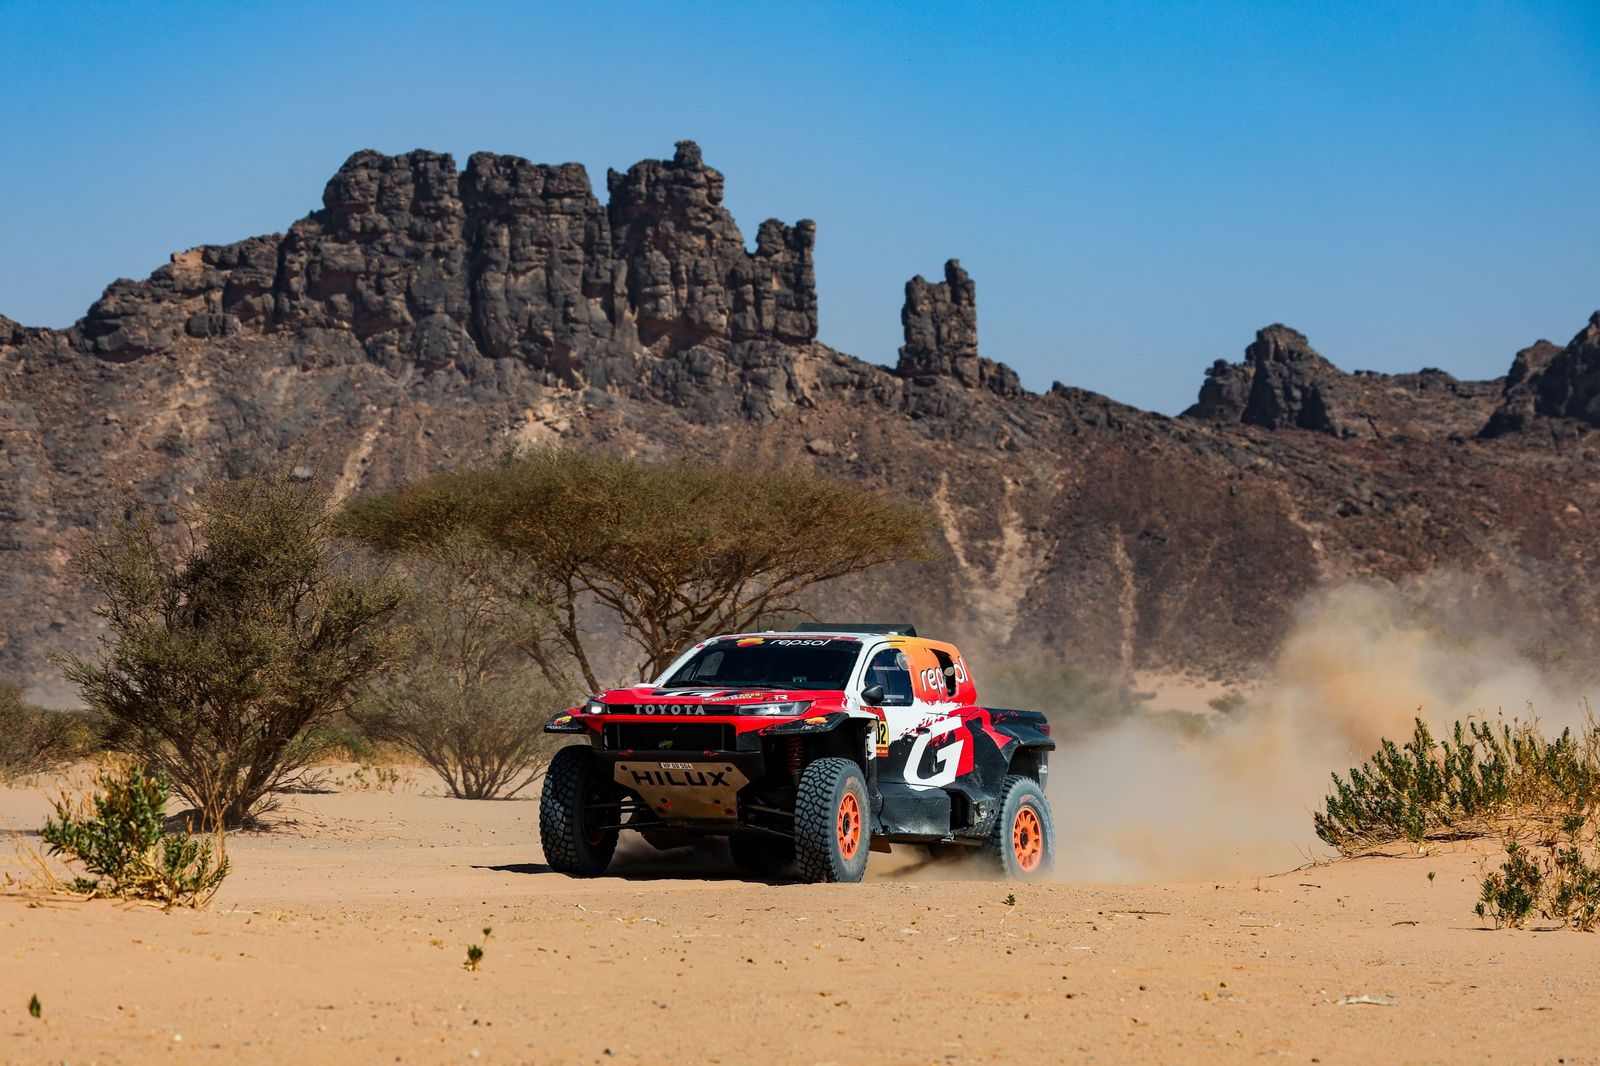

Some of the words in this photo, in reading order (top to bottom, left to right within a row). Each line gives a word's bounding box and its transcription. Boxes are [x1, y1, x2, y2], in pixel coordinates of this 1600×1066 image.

[920, 656, 969, 694] repol
[634, 704, 705, 715] TOYOTA
[631, 771, 731, 786] HILUX
